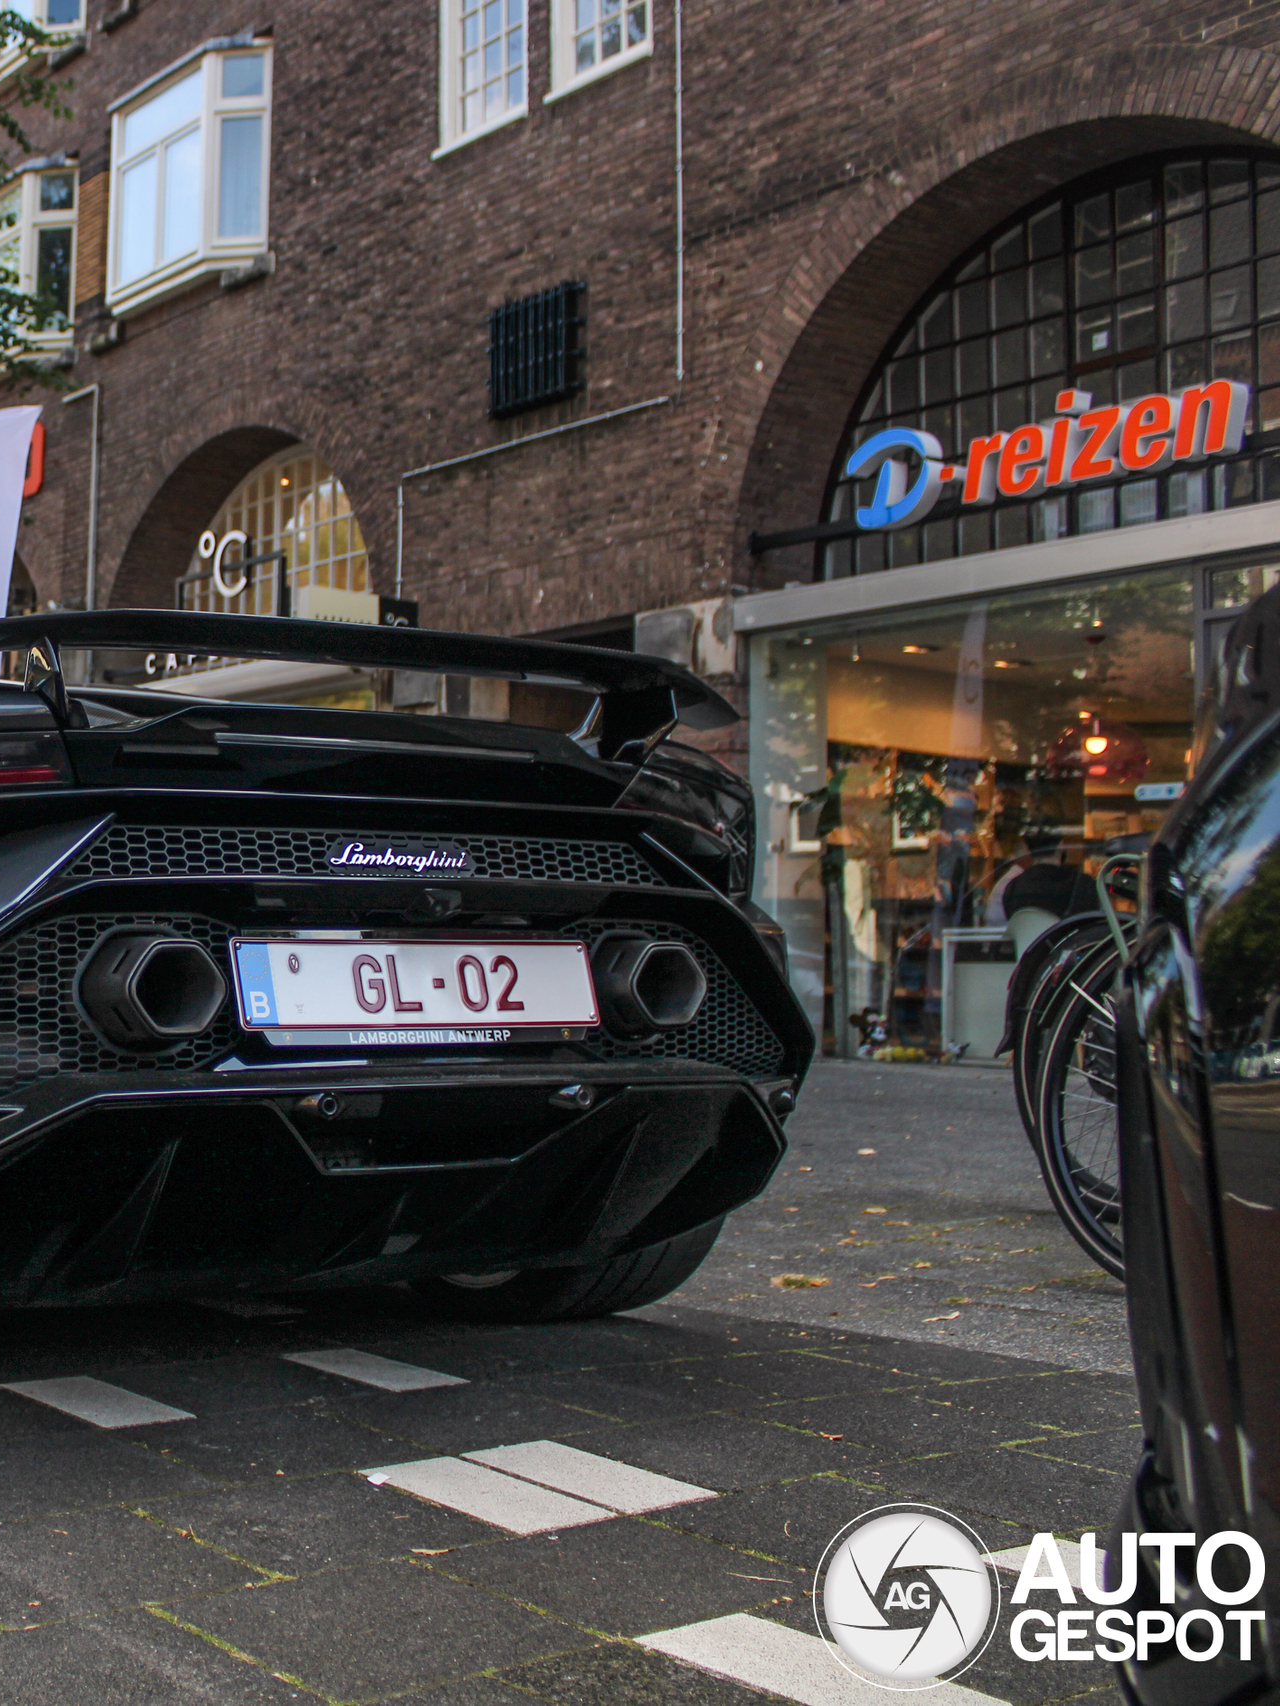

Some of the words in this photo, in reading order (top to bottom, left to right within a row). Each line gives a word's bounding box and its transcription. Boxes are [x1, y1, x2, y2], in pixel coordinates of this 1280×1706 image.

[847, 380, 1239, 529] D-reizen
[330, 842, 467, 872] Lamborghini
[250, 991, 270, 1018] B
[349, 1031, 444, 1044] LAMBORGHINI
[448, 1030, 511, 1042] ANTWERP
